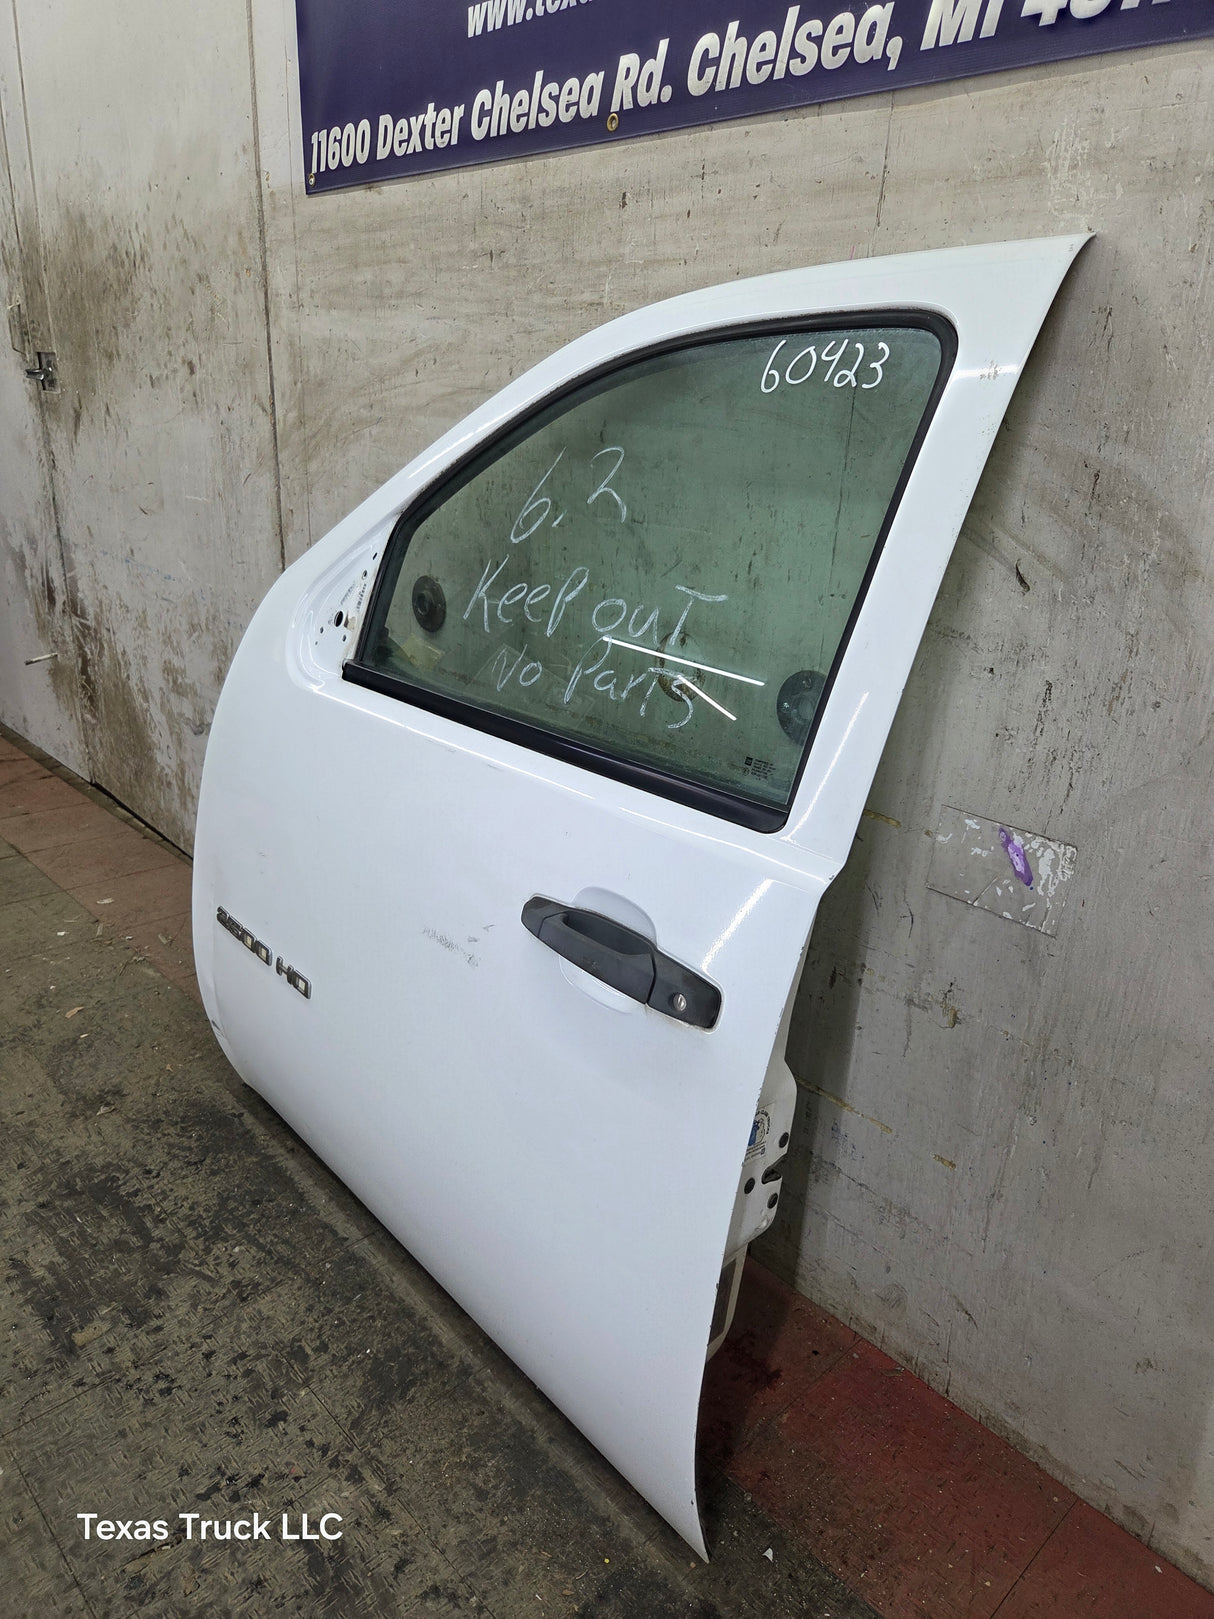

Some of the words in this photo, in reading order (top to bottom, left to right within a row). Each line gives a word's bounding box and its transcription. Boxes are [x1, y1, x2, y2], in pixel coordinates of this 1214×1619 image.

[467, 0, 595, 38] www.
[310, 118, 372, 174] 11600
[376, 103, 465, 161] Dexter
[470, 69, 605, 142] Chelsea
[611, 37, 673, 113] Rd.
[687, 1, 904, 97] Chelsea,
[760, 338, 890, 394] 60423
[491, 643, 543, 692] No
[276, 955, 312, 1000] HD
